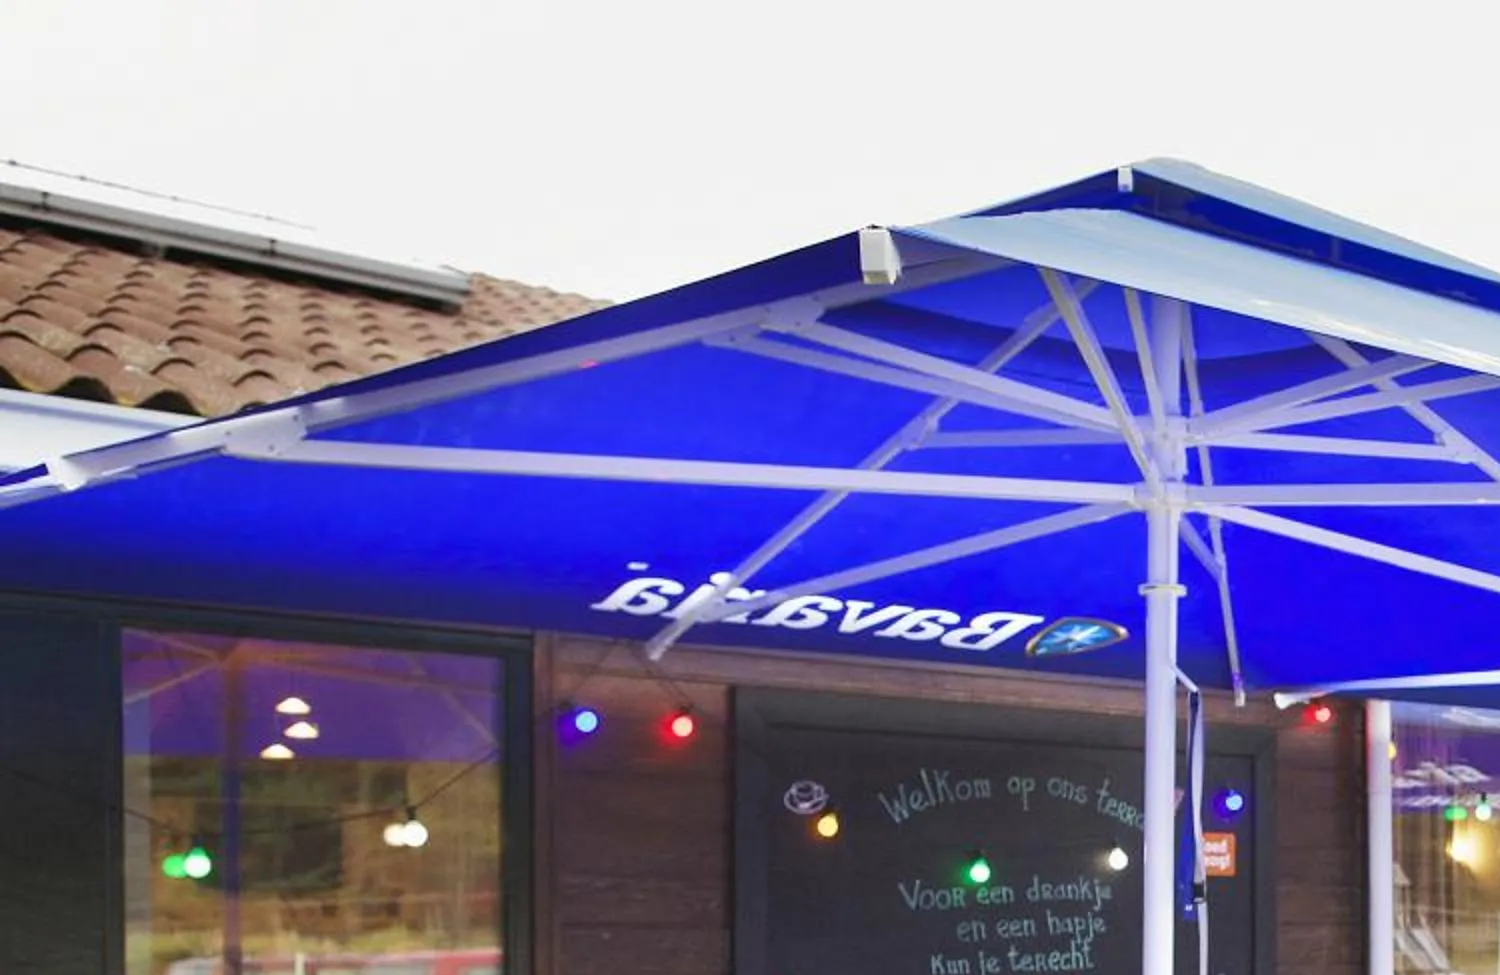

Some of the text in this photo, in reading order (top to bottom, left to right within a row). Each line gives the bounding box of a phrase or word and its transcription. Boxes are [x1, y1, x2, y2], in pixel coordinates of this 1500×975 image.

[1007, 776, 1035, 811] op
[1047, 777, 1088, 804] ons
[976, 885, 1015, 905] een
[1026, 874, 1112, 911] drankje
[956, 909, 1106, 943] en een hapje
[1007, 940, 1095, 973] terecht
